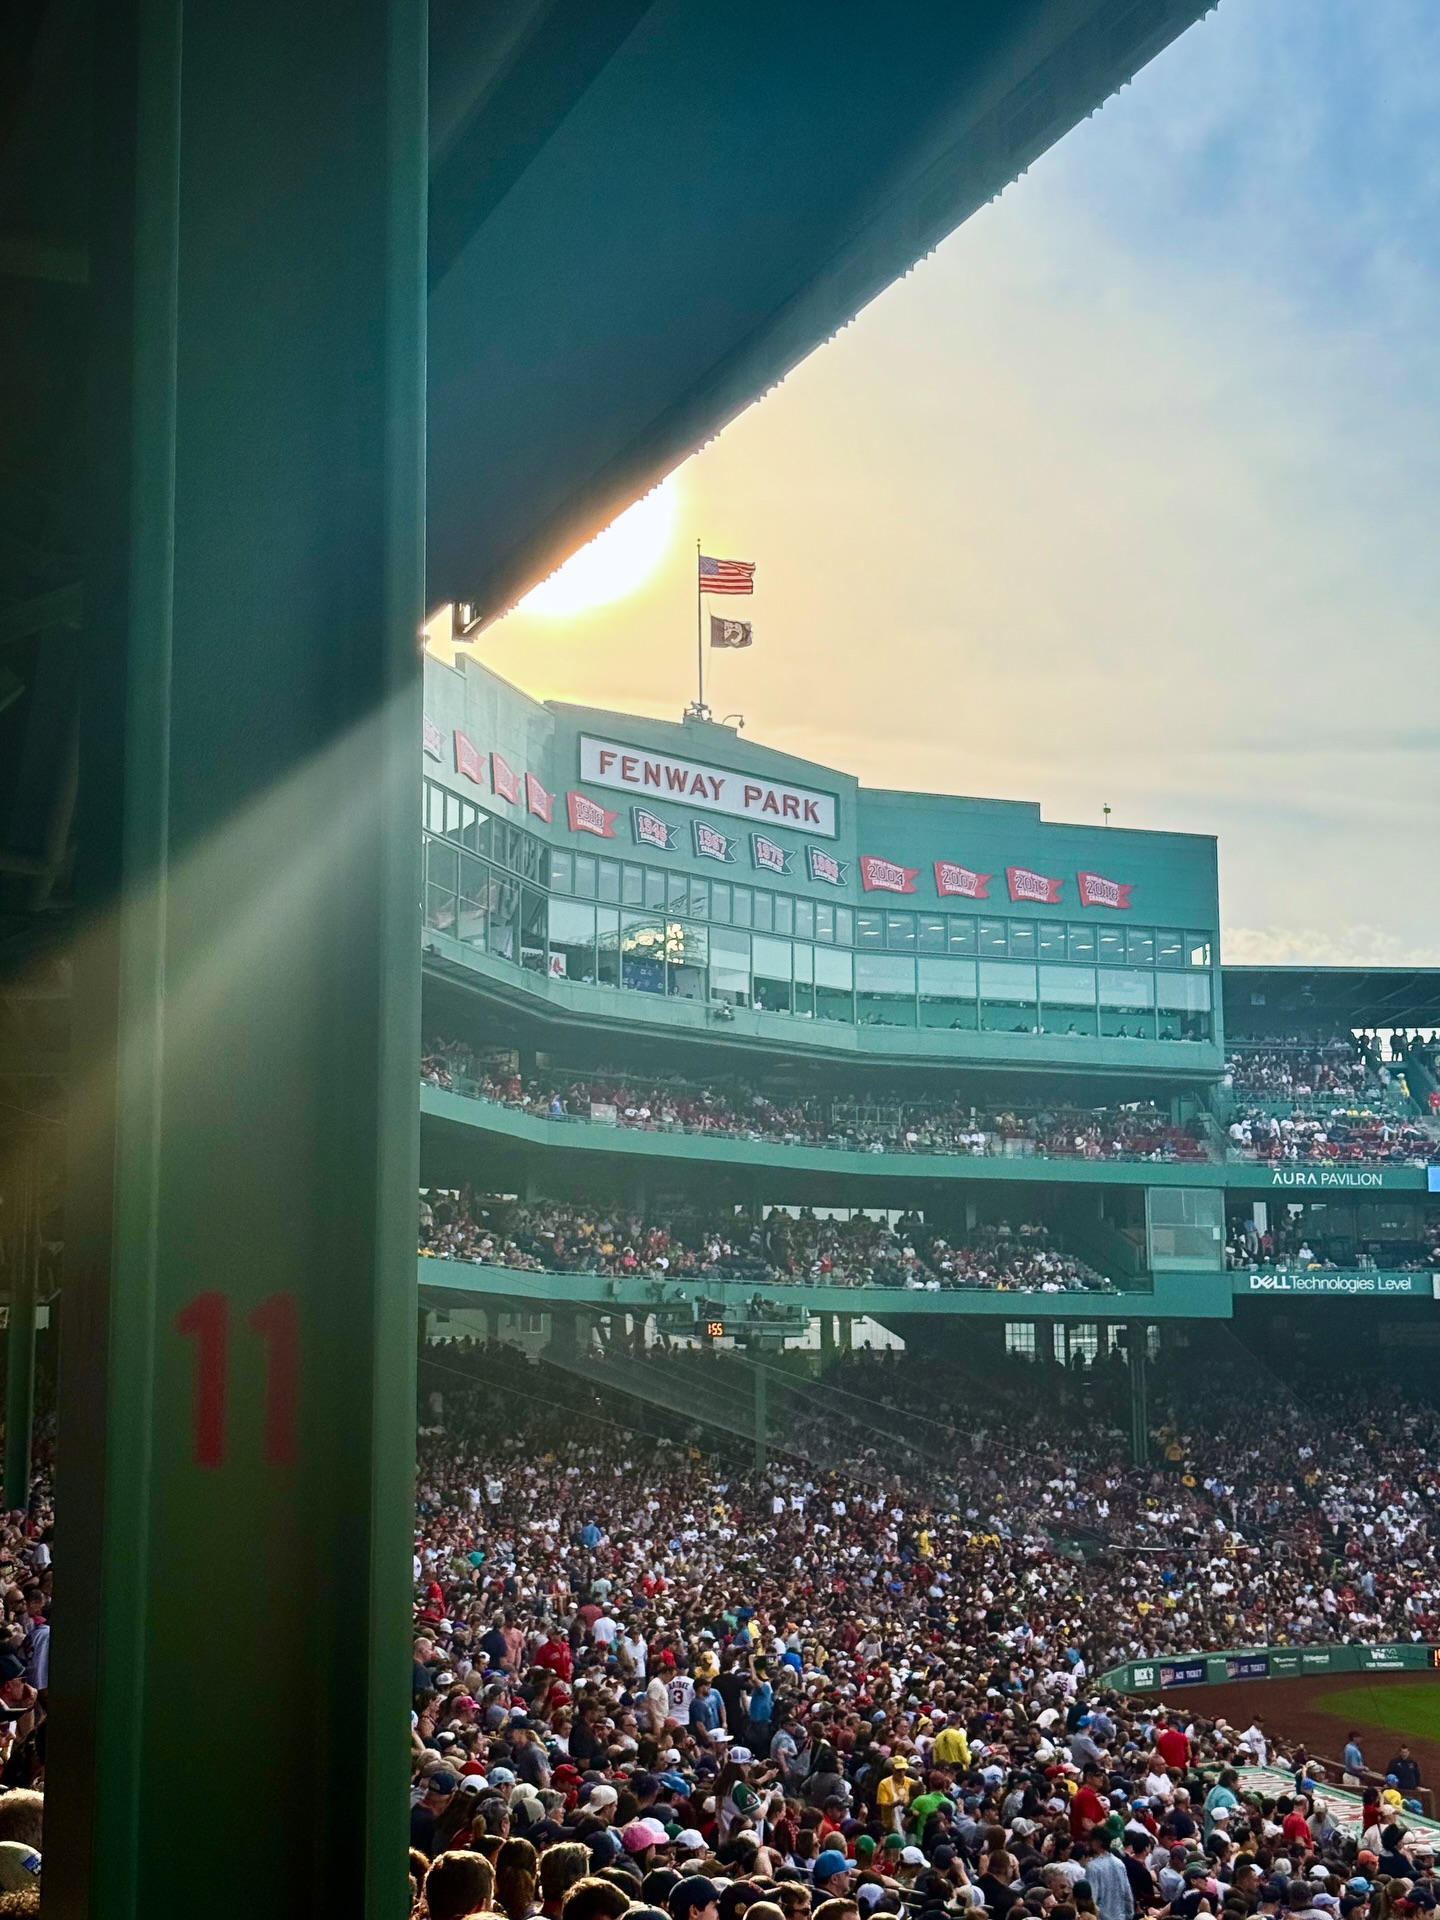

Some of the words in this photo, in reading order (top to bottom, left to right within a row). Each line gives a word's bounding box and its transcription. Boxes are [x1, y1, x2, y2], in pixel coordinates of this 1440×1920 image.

[600, 750, 726, 801] FENWAY
[744, 785, 821, 824] PARK
[576, 803, 604, 828] 1918
[638, 816, 668, 842] 1946
[698, 829, 727, 854] 1967
[756, 842, 784, 866] 1975
[867, 864, 905, 886] 2004
[940, 869, 978, 891] 2007
[1014, 875, 1049, 896] 2013
[1085, 880, 1119, 902] 2018
[1321, 1173, 1383, 1186] PAVILION
[1378, 1277, 1412, 1290] Level
[176, 1291, 299, 1468] 11
[1175, 1671, 1184, 1679] ACE
[1186, 1669, 1202, 1678] TICKET
[1250, 1663, 1266, 1672] TICKET
[673, 1689, 684, 1705] 3
